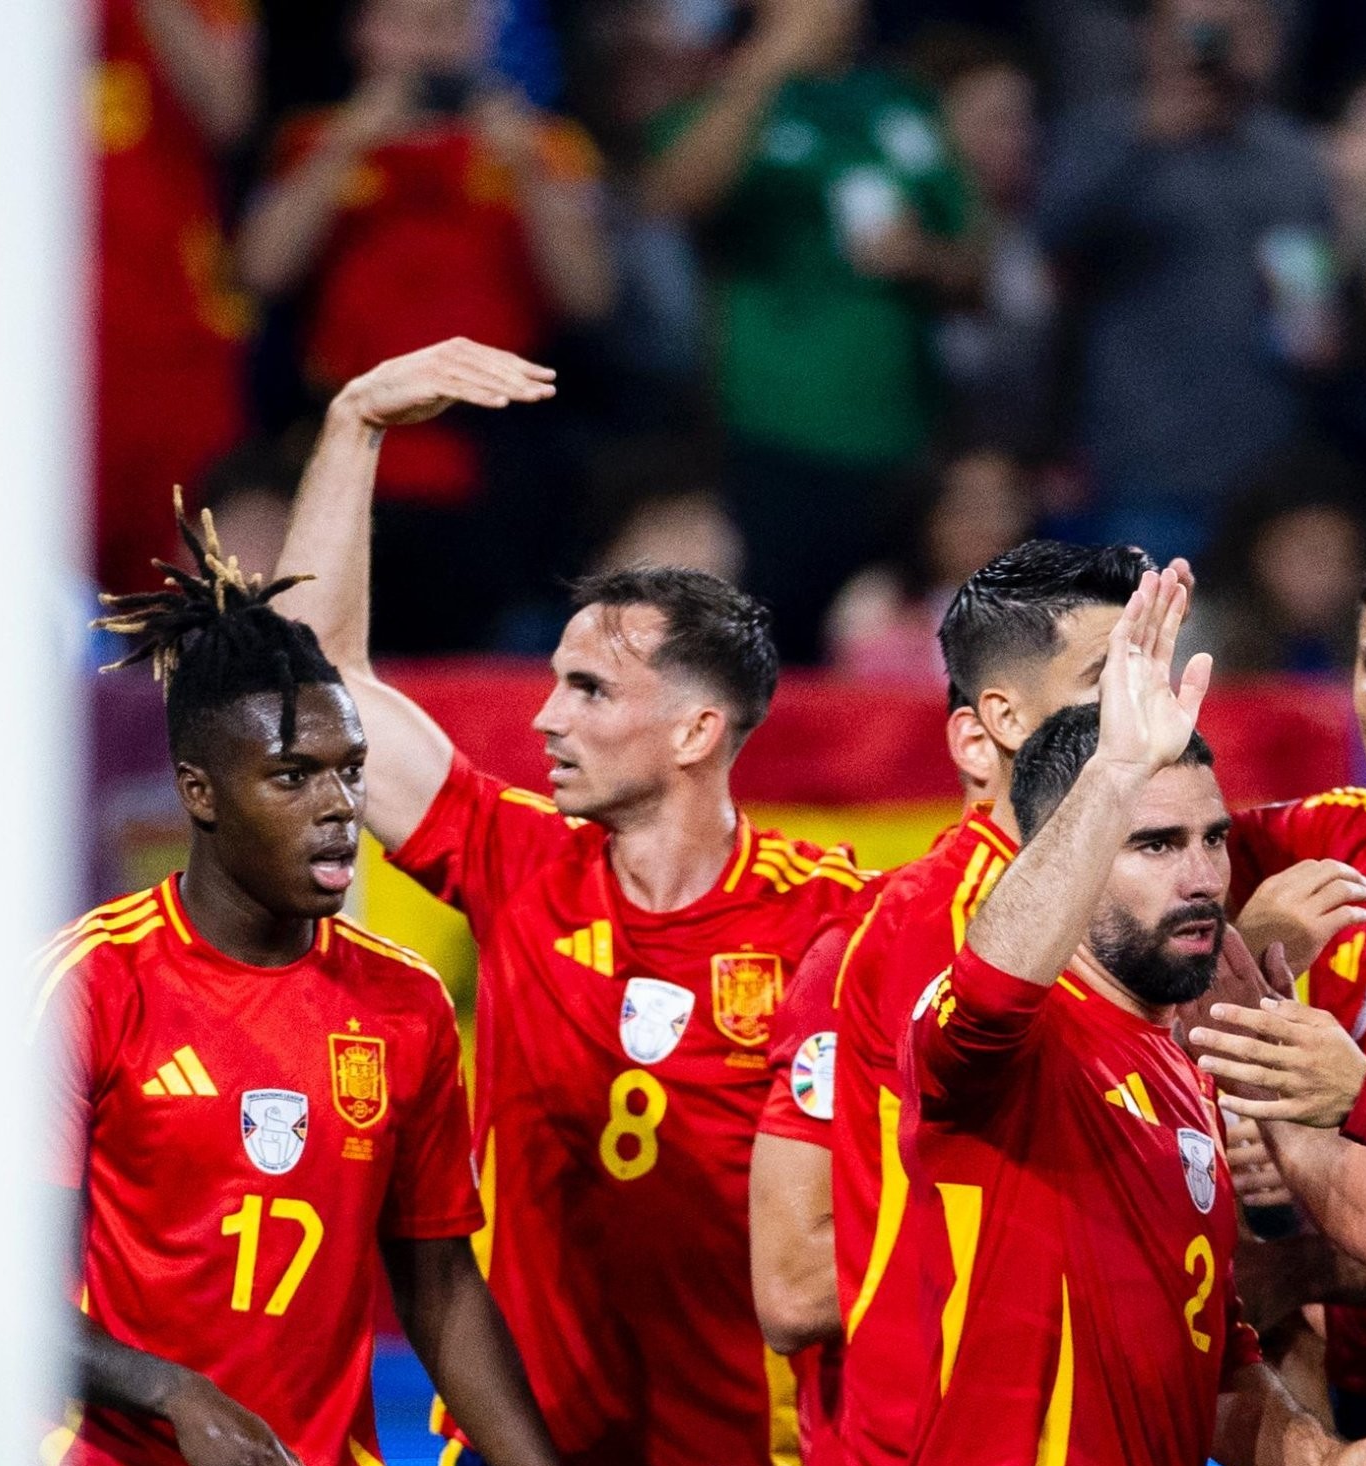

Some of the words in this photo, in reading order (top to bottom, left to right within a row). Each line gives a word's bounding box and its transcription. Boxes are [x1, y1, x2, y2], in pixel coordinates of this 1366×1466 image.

[599, 1069, 668, 1181] 8
[221, 1195, 325, 1316] 17
[1184, 1234, 1215, 1354] 2
